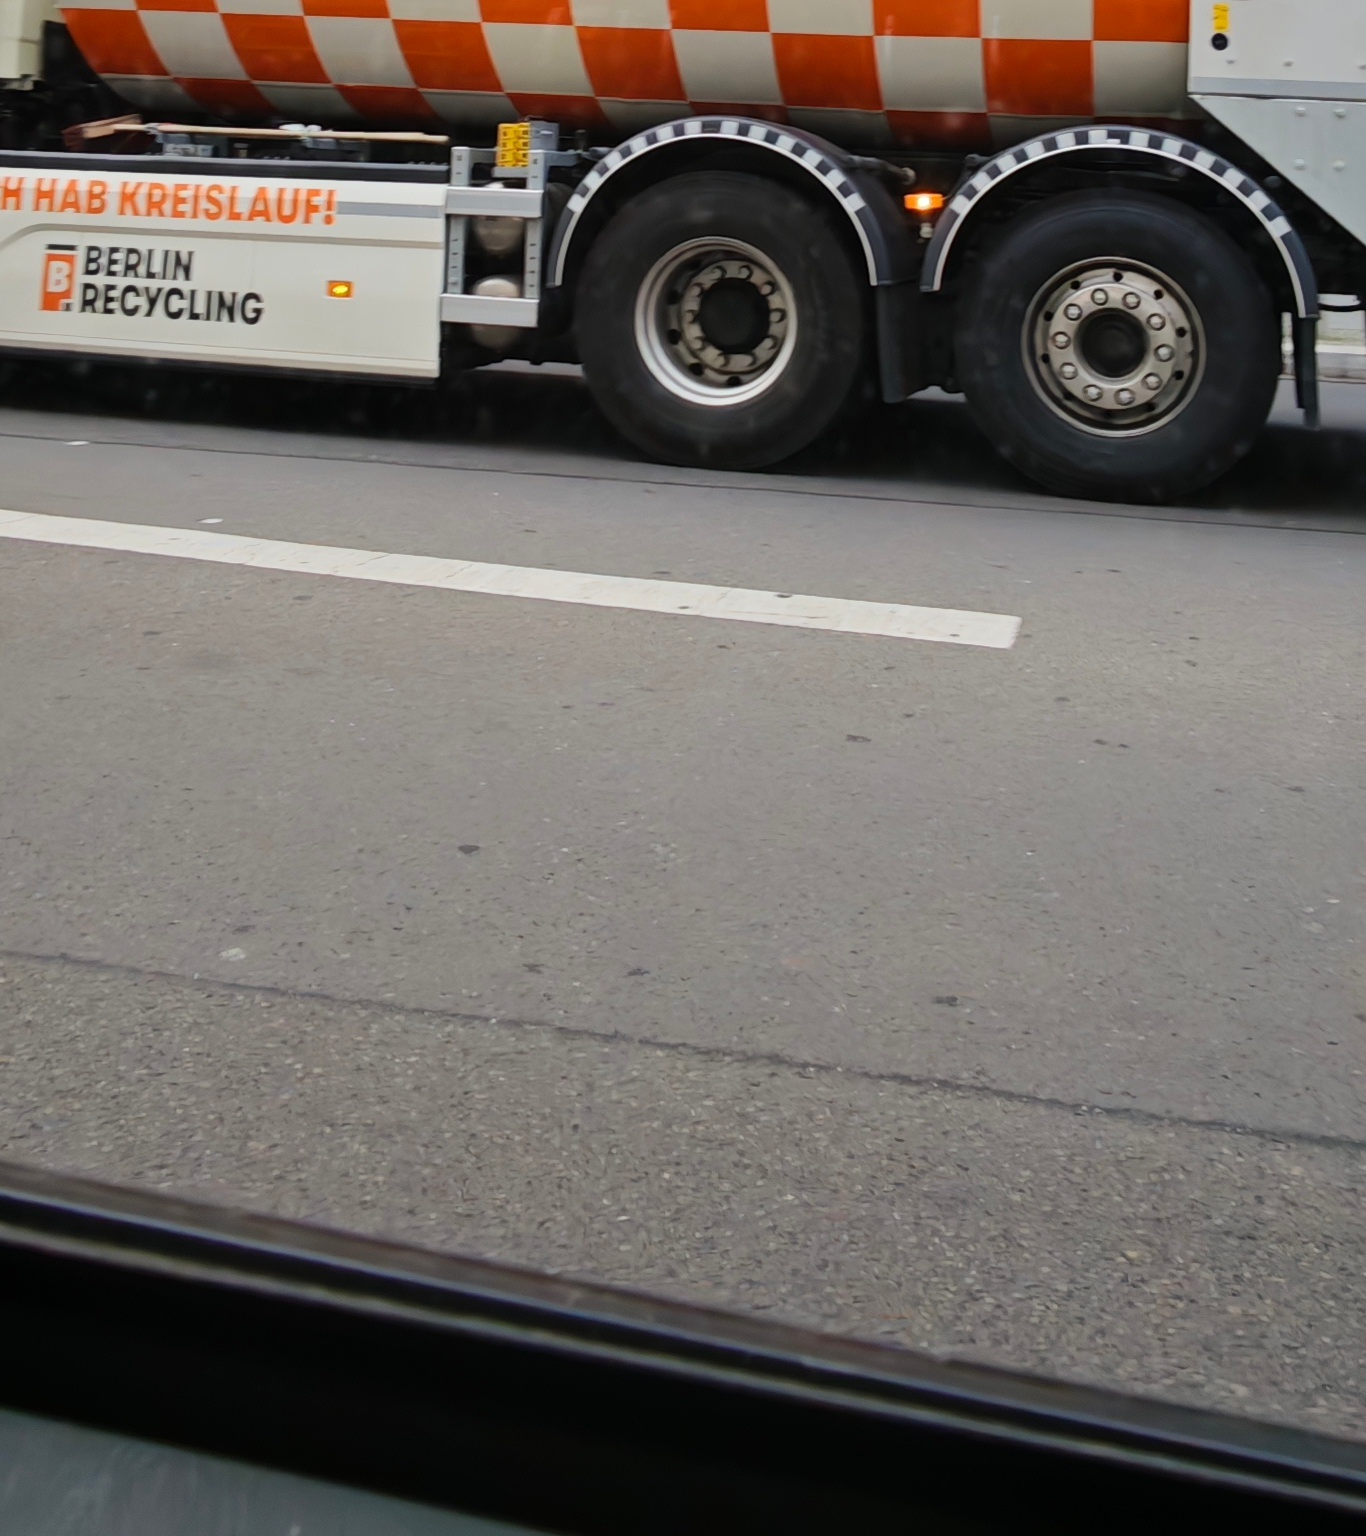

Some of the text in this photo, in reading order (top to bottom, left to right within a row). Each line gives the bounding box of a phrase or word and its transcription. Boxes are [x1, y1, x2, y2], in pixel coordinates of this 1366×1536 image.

[31, 177, 109, 215] HAB
[117, 180, 338, 226] KREISLAUF!
[82, 245, 195, 282] BERLIN
[79, 282, 266, 325] RECYCLING
